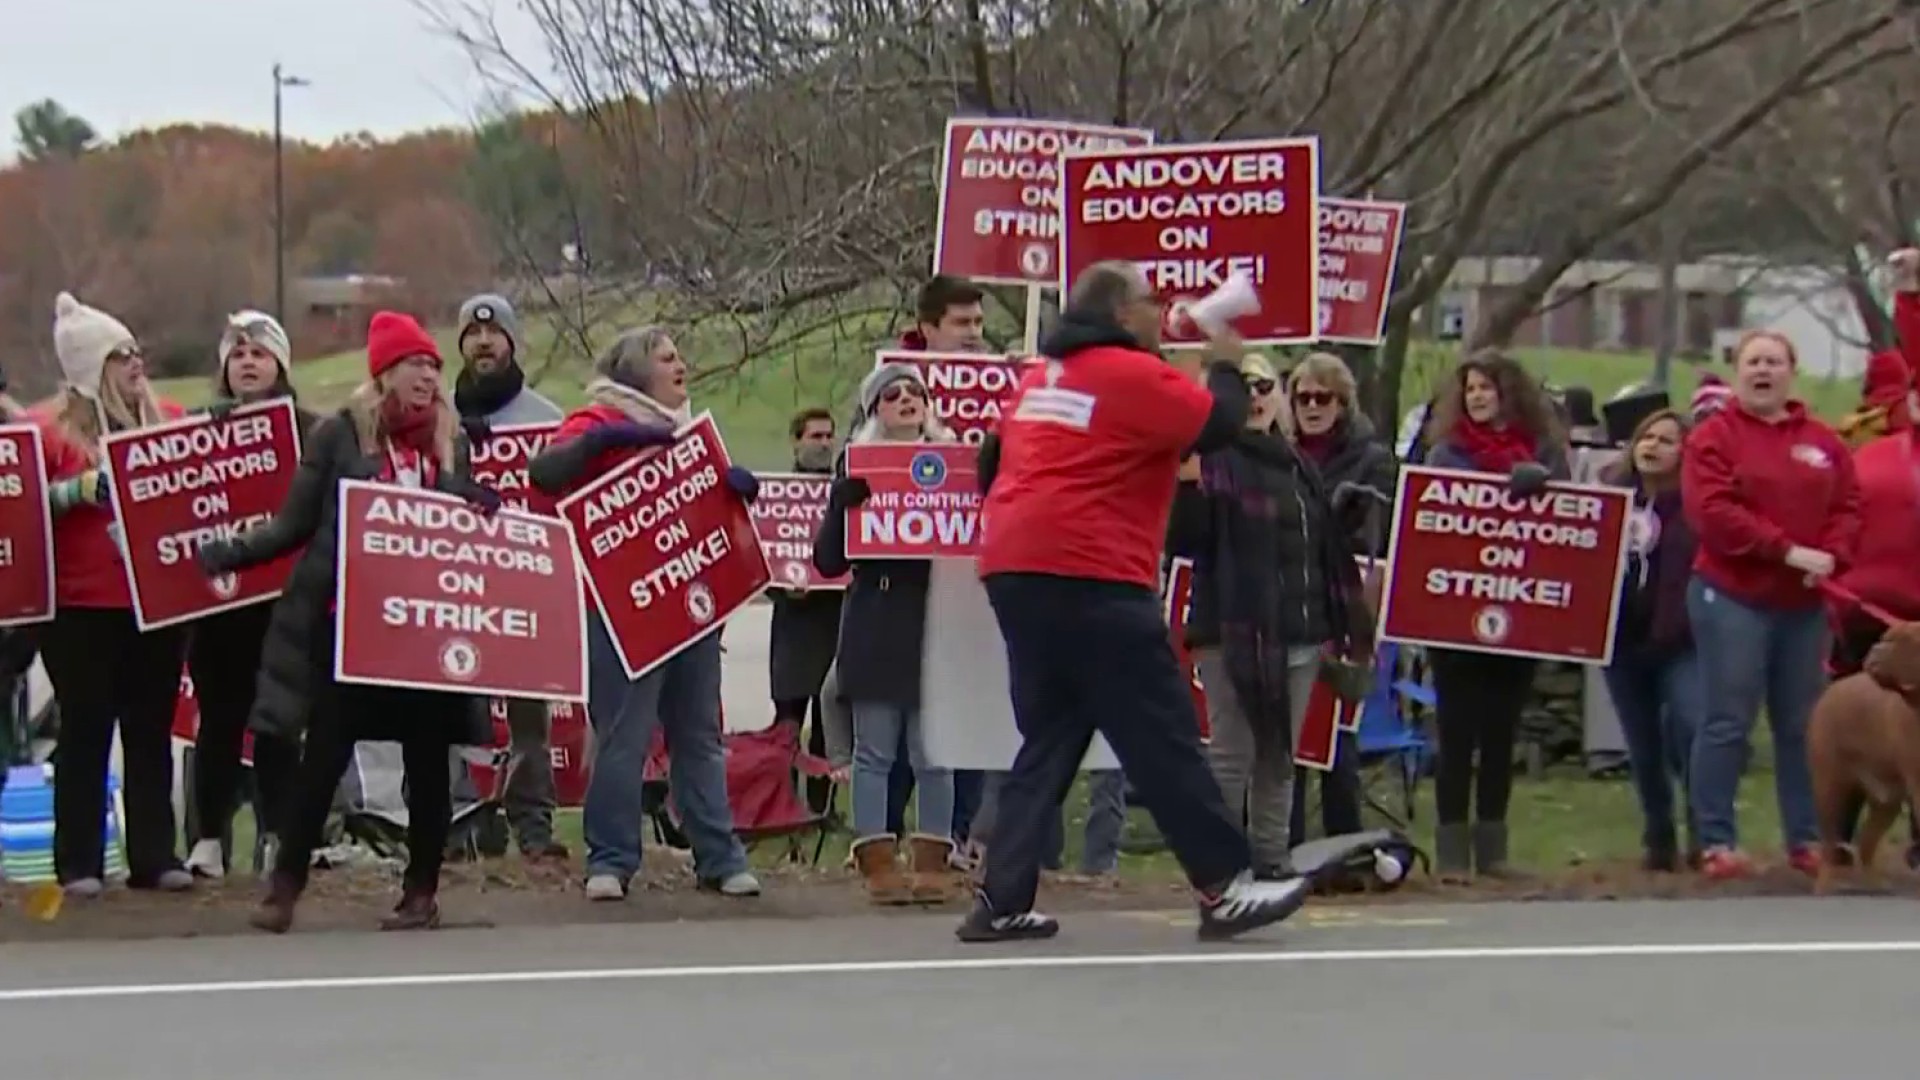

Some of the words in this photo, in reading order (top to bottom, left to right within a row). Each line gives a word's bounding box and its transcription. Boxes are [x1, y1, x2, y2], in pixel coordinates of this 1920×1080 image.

[961, 157, 1058, 180] EDUCA
[1083, 153, 1284, 191] ANDOVER
[1082, 190, 1285, 223] EDUCATORS
[1319, 207, 1390, 232] DOVER
[1159, 225, 1208, 251] ON
[1137, 254, 1265, 290] TRIKE!
[126, 415, 273, 471] ANDOVER
[130, 450, 278, 502] EDUCATORS
[583, 434, 708, 530] ANDOVER
[192, 492, 229, 518] ON
[590, 465, 718, 558] EDUCATORS
[870, 492, 899, 508] AIR
[903, 492, 981, 508] CONTRAC
[366, 497, 549, 547] ANDOVER
[654, 519, 690, 552] ON
[777, 523, 810, 539] ON
[1414, 510, 1598, 549] EDUCATORS
[363, 531, 553, 574] EDUCATORS
[629, 525, 731, 608] STRIKE!
[1479, 545, 1525, 568] ON
[438, 570, 484, 596] ON
[1426, 568, 1572, 608] STRIKE!
[382, 597, 538, 638] STRIKE!
